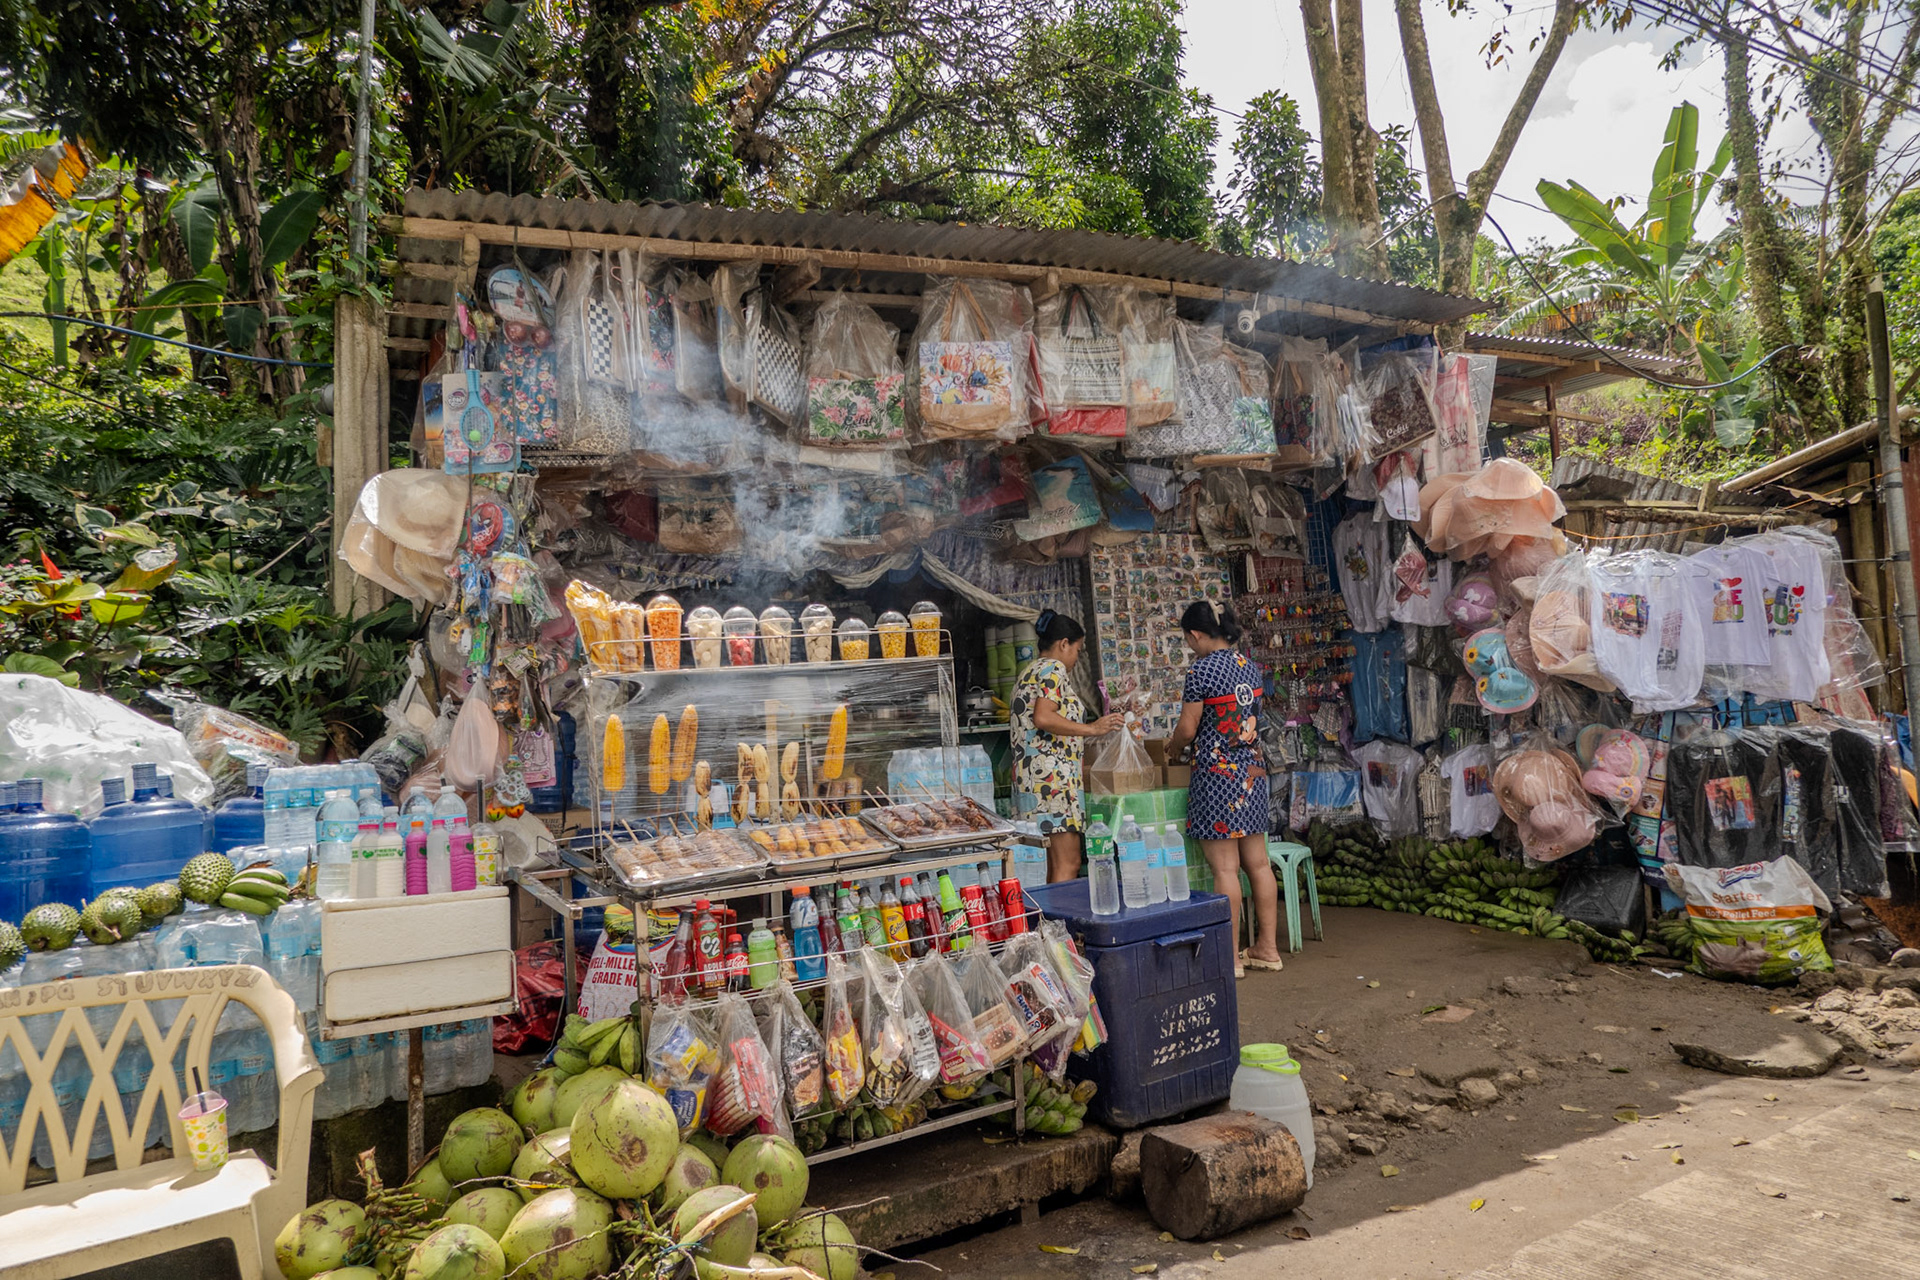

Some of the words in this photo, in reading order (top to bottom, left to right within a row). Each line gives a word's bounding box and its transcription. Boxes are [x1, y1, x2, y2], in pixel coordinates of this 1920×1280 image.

[1386, 423, 1410, 439] Cebu
[1711, 890, 1763, 905] Starter
[1751, 908, 1777, 918] Feed
[700, 935, 721, 956] C2
[592, 971, 623, 986] GRADE
